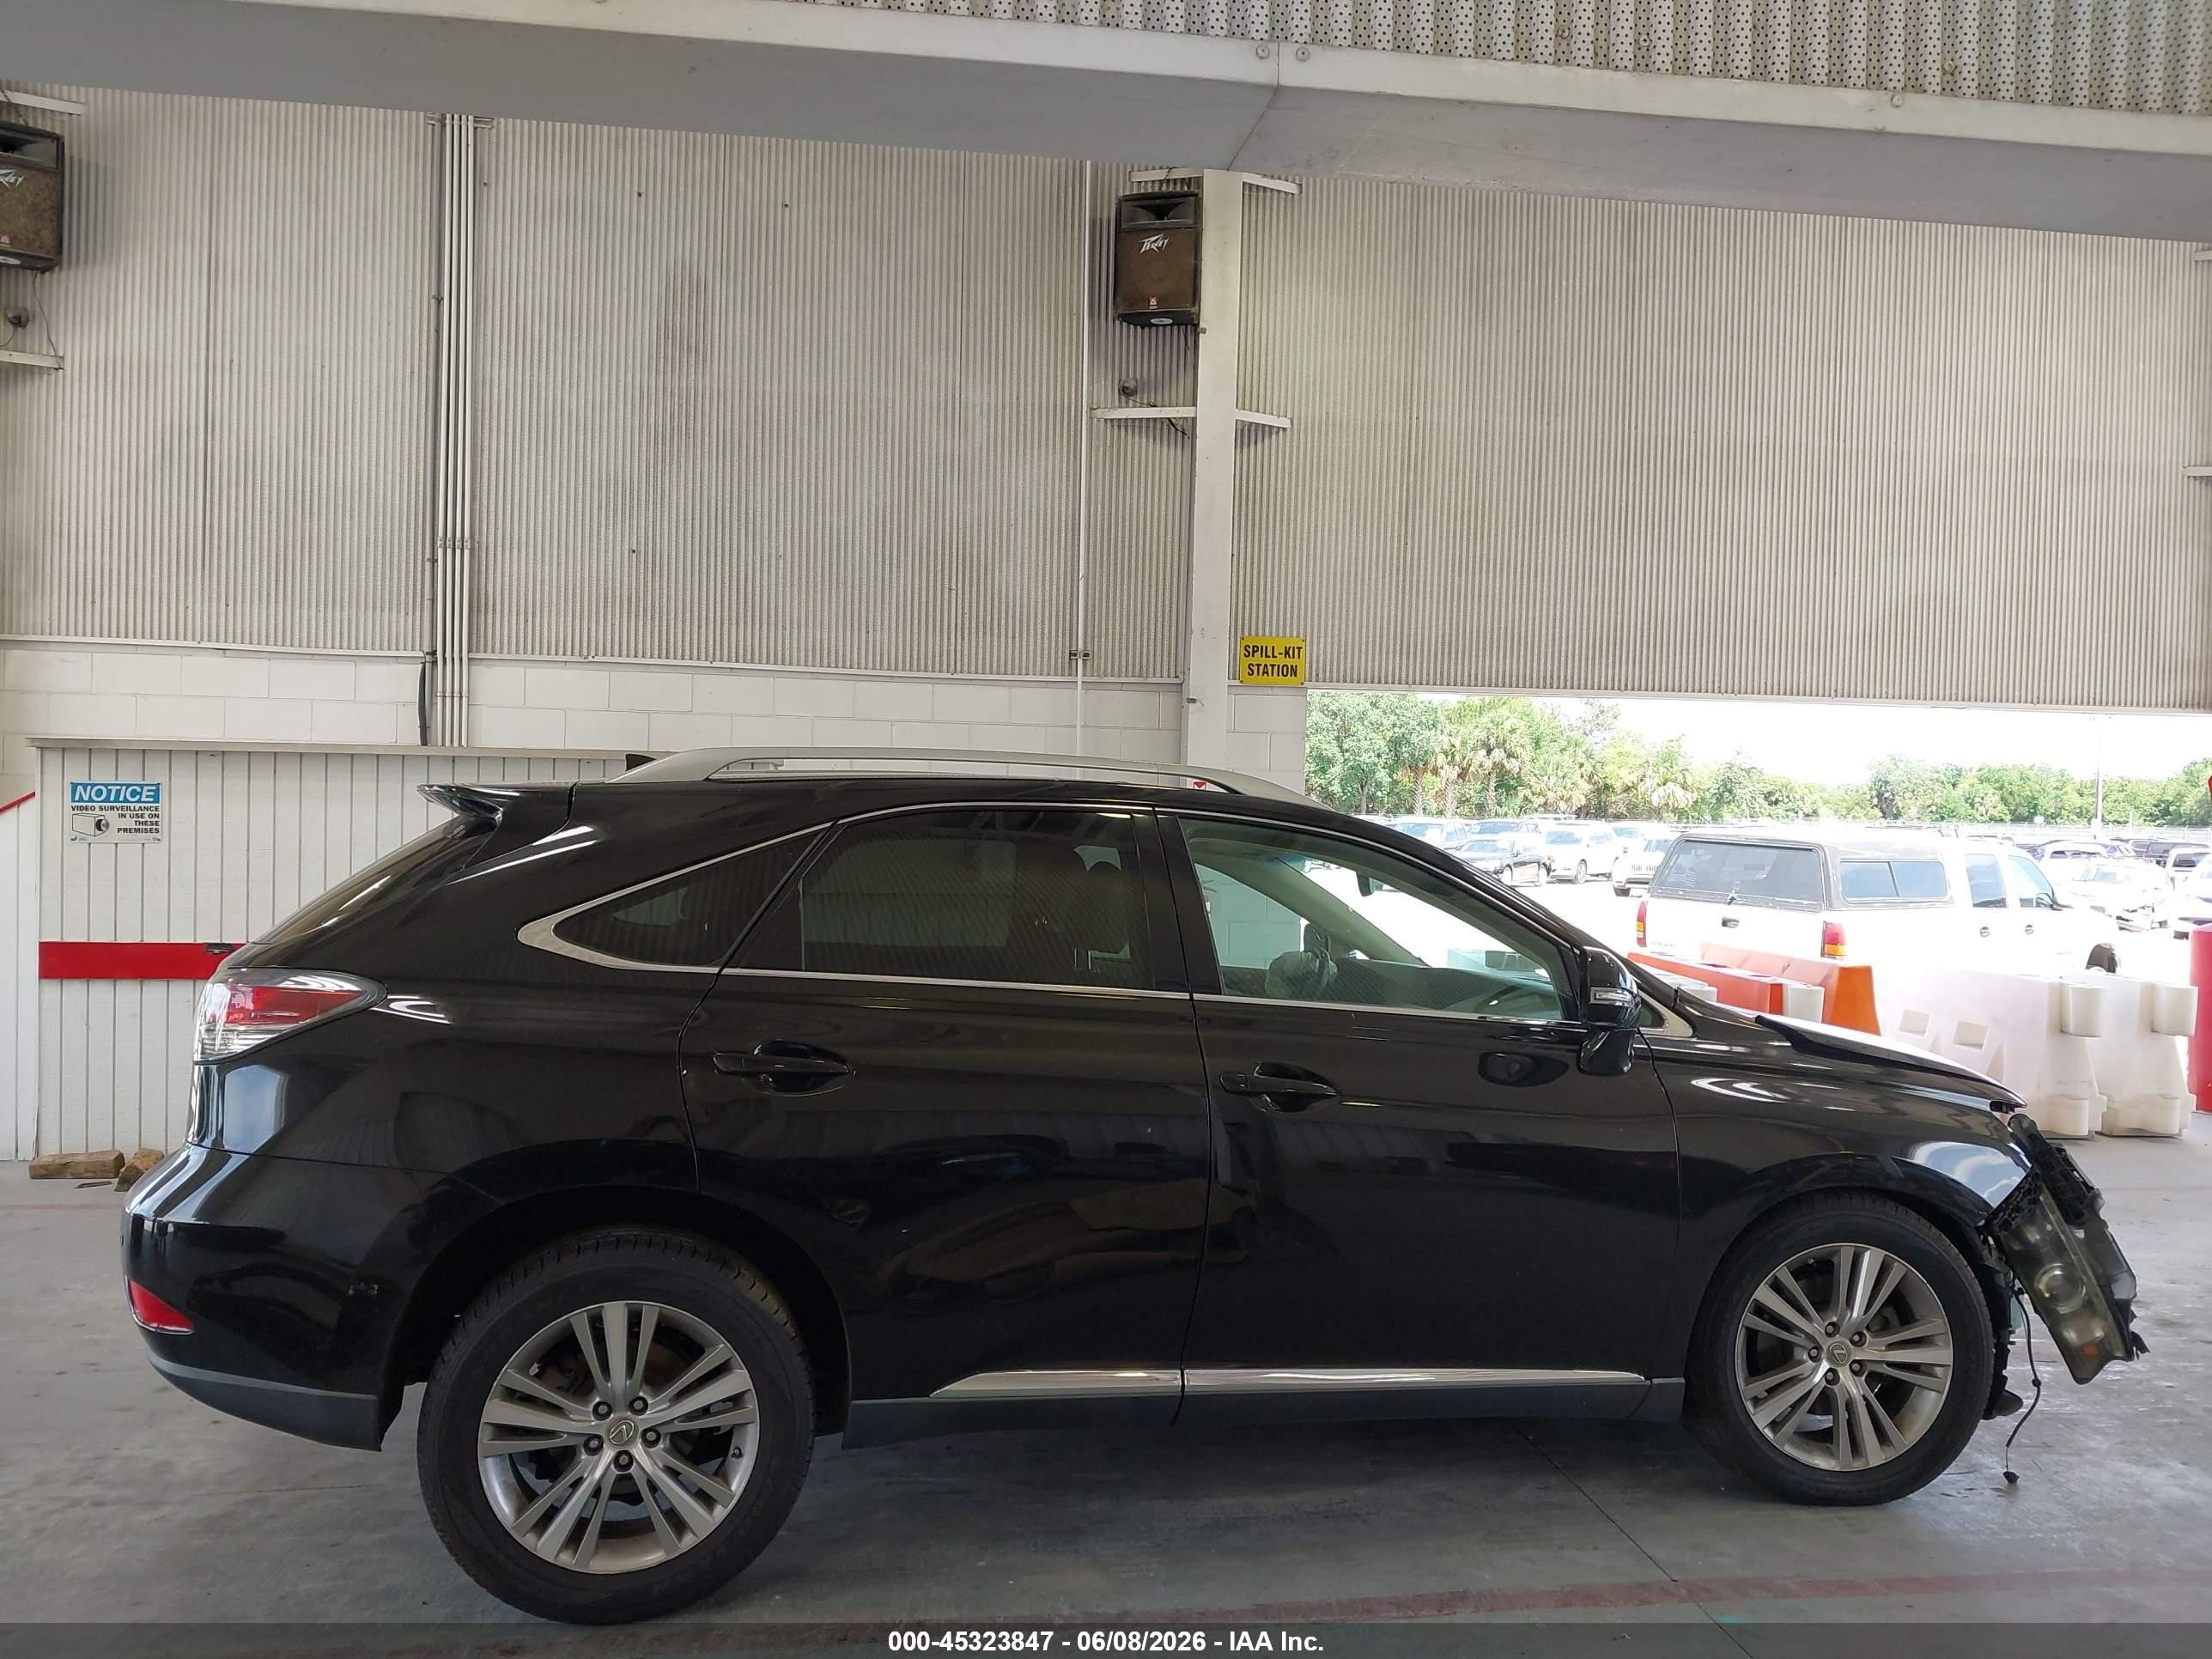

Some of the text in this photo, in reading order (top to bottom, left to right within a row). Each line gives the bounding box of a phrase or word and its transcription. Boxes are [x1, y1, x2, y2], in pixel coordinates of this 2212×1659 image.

[1243, 644, 1303, 659] SPILL-KIT
[1247, 663, 1297, 678] STATION
[74, 785, 156, 802] NOTICE
